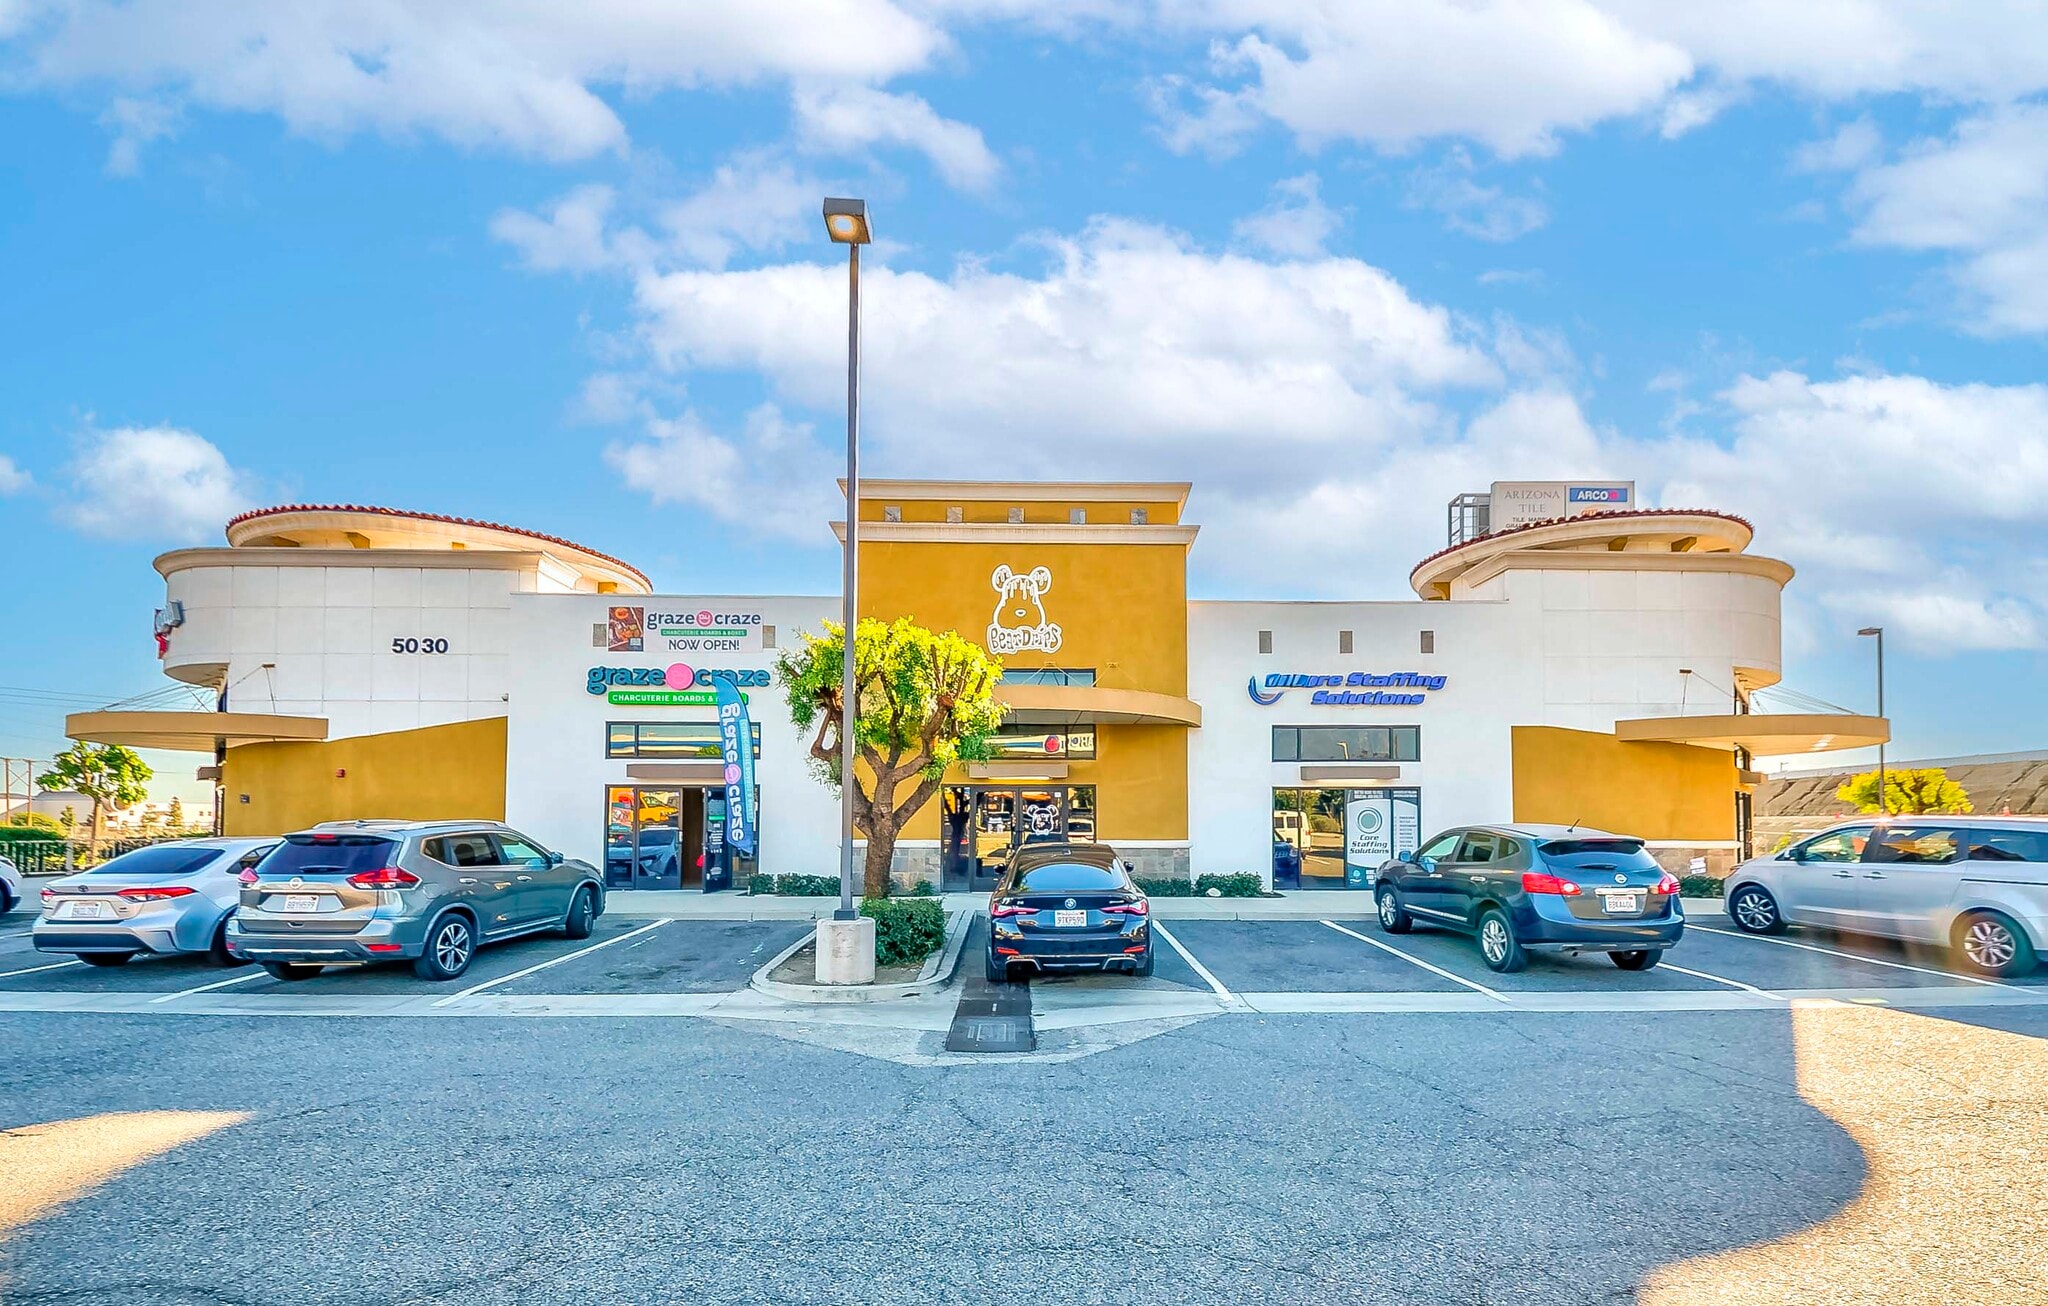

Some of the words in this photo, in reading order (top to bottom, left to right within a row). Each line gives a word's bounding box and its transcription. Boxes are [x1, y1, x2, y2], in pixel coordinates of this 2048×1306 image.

[1504, 490, 1560, 499] ARIZONA
[1577, 490, 1609, 501] ARCO
[1518, 504, 1546, 513] TILE
[646, 612, 695, 630] graze
[714, 614, 761, 625] craze
[391, 637, 449, 654] 5030
[668, 640, 700, 651] NOW
[703, 640, 740, 651] OPEN!
[586, 665, 666, 696] graze
[1345, 672, 1447, 691] Staffing
[612, 694, 670, 703] CHARCUTERIE
[672, 694, 706, 703] BOARDS
[707, 695, 714, 703] &
[1311, 690, 1426, 706] Solutions
[1351, 840, 1388, 849] Staffing
[1349, 847, 1390, 855] Solutions
